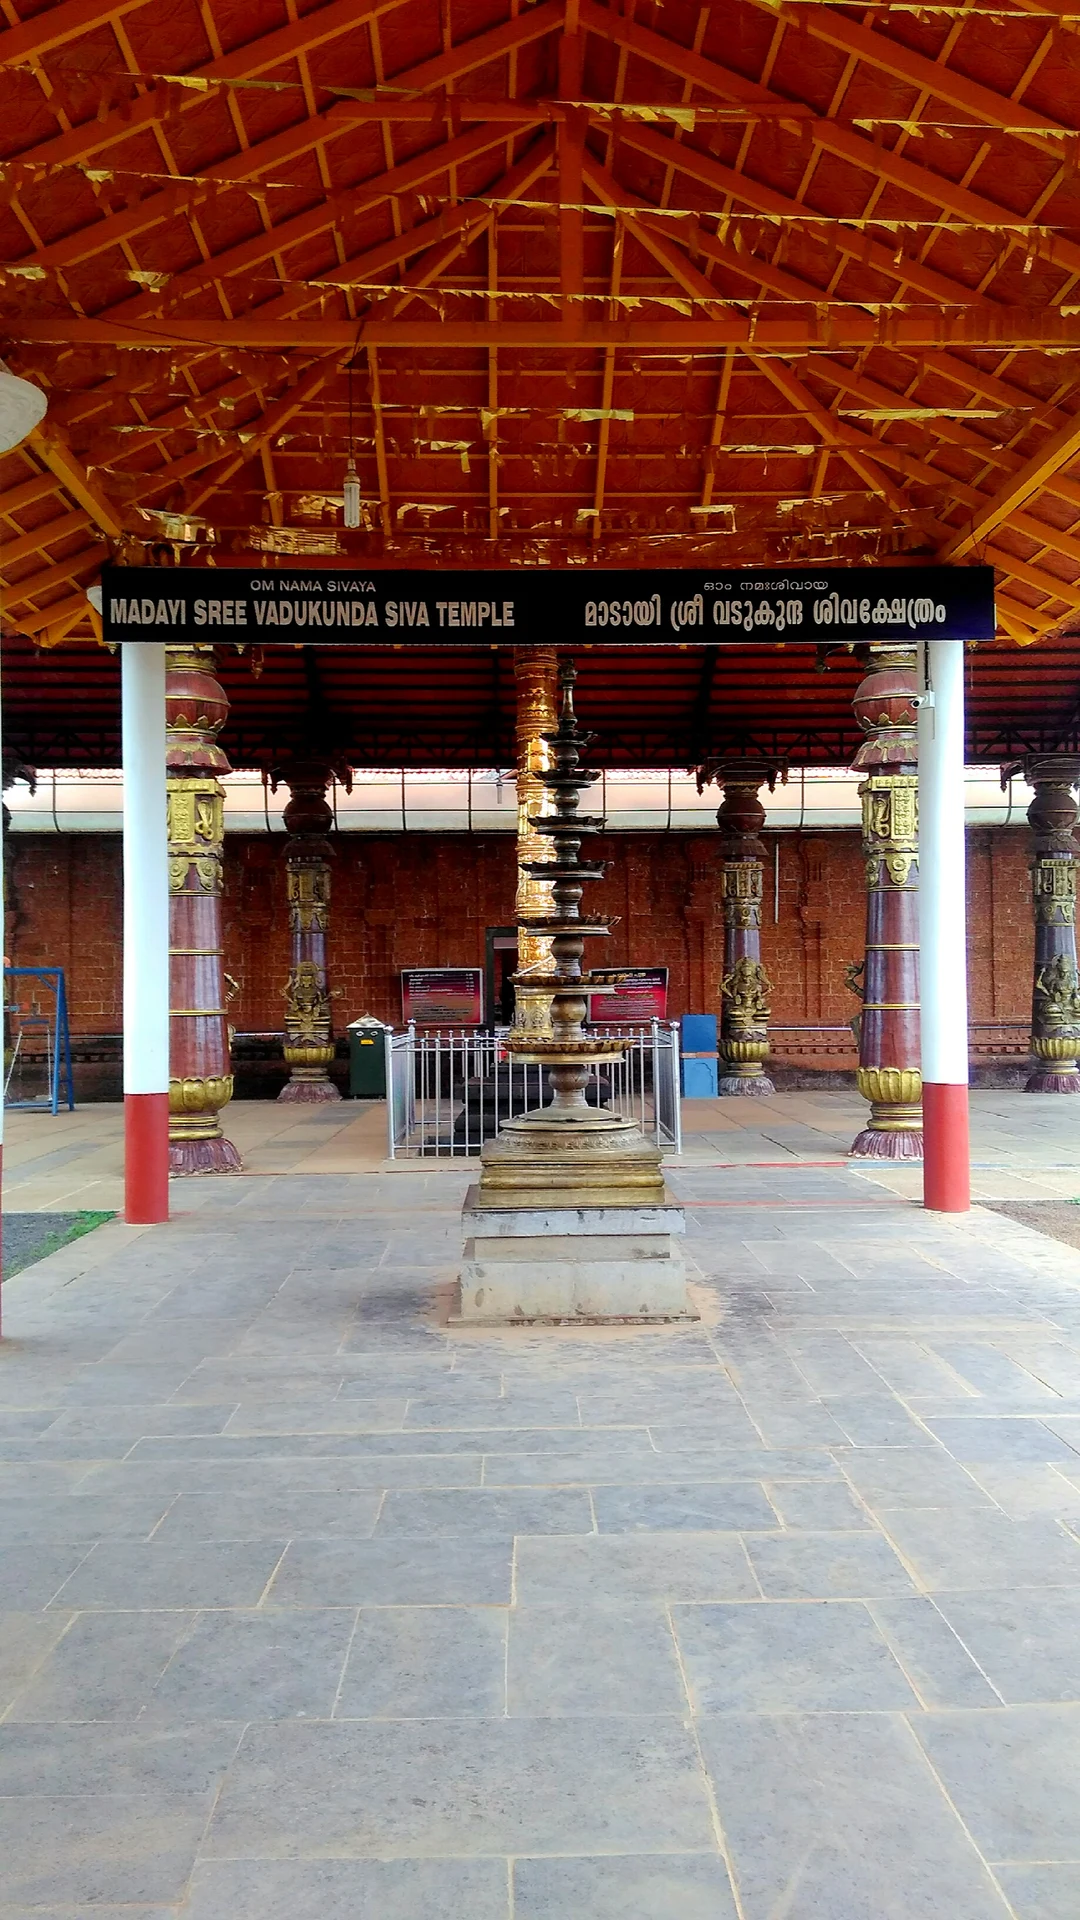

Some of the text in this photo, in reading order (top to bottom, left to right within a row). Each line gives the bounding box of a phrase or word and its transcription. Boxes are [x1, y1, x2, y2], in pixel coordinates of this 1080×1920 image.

[250, 580, 377, 593] OM NAMA SIVAYA
[703, 579, 829, 591] ഓം നമഃശിവായ
[110, 598, 515, 627] MADAYI SREE VADUKUNDA SIVA TEMPLE
[584, 592, 947, 632] മാടായി ശ്രീ വടുകുന്ദ ശിവക്ഷേത്രം
